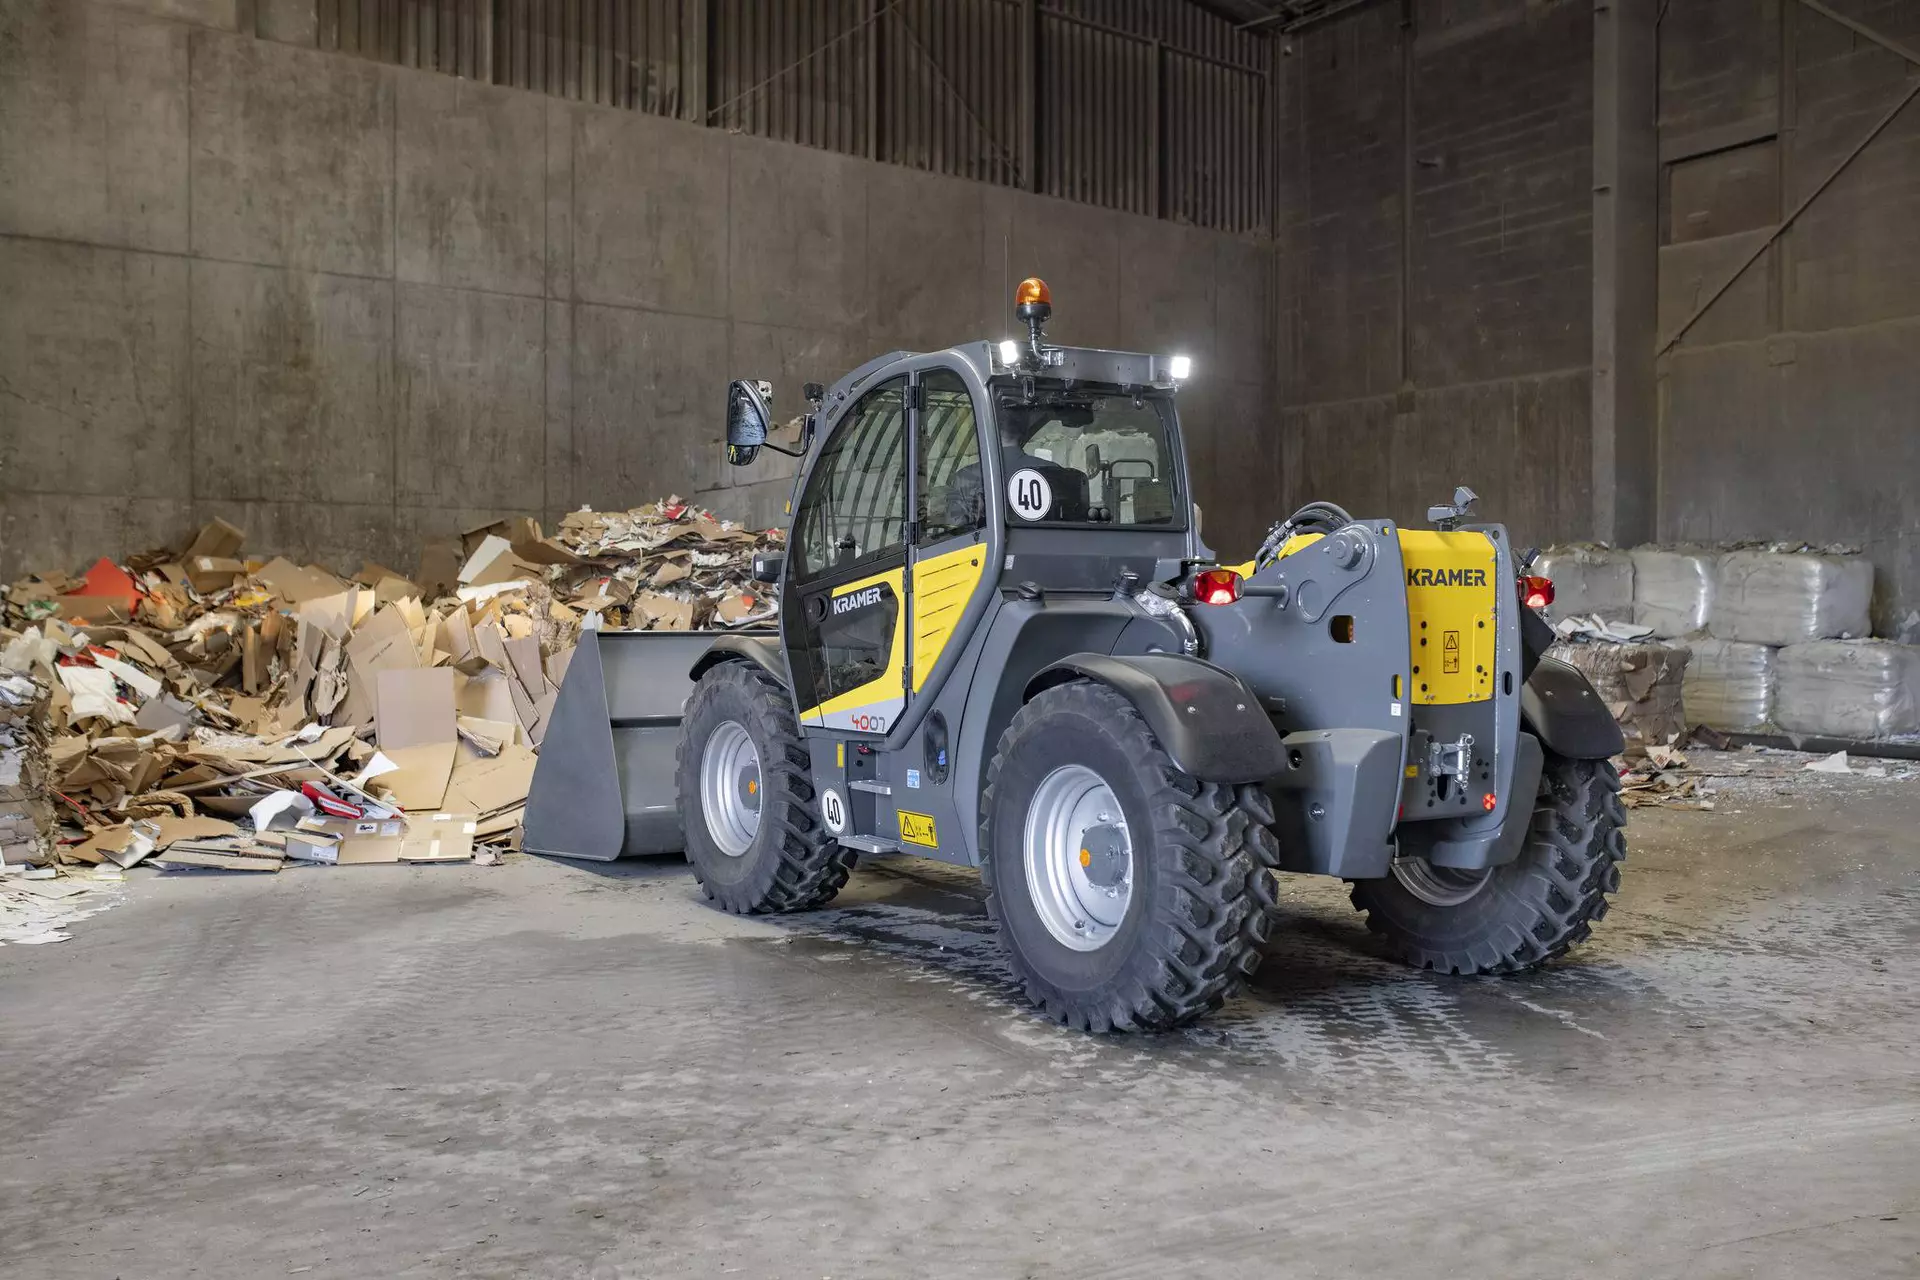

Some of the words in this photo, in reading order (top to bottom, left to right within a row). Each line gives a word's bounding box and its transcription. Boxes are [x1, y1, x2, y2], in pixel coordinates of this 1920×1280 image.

[1018, 479, 1042, 511] 40
[1407, 568, 1487, 587] KRAMER
[833, 587, 882, 615] KRAMER
[851, 714, 886, 732] 4007
[826, 796, 841, 826] 40
